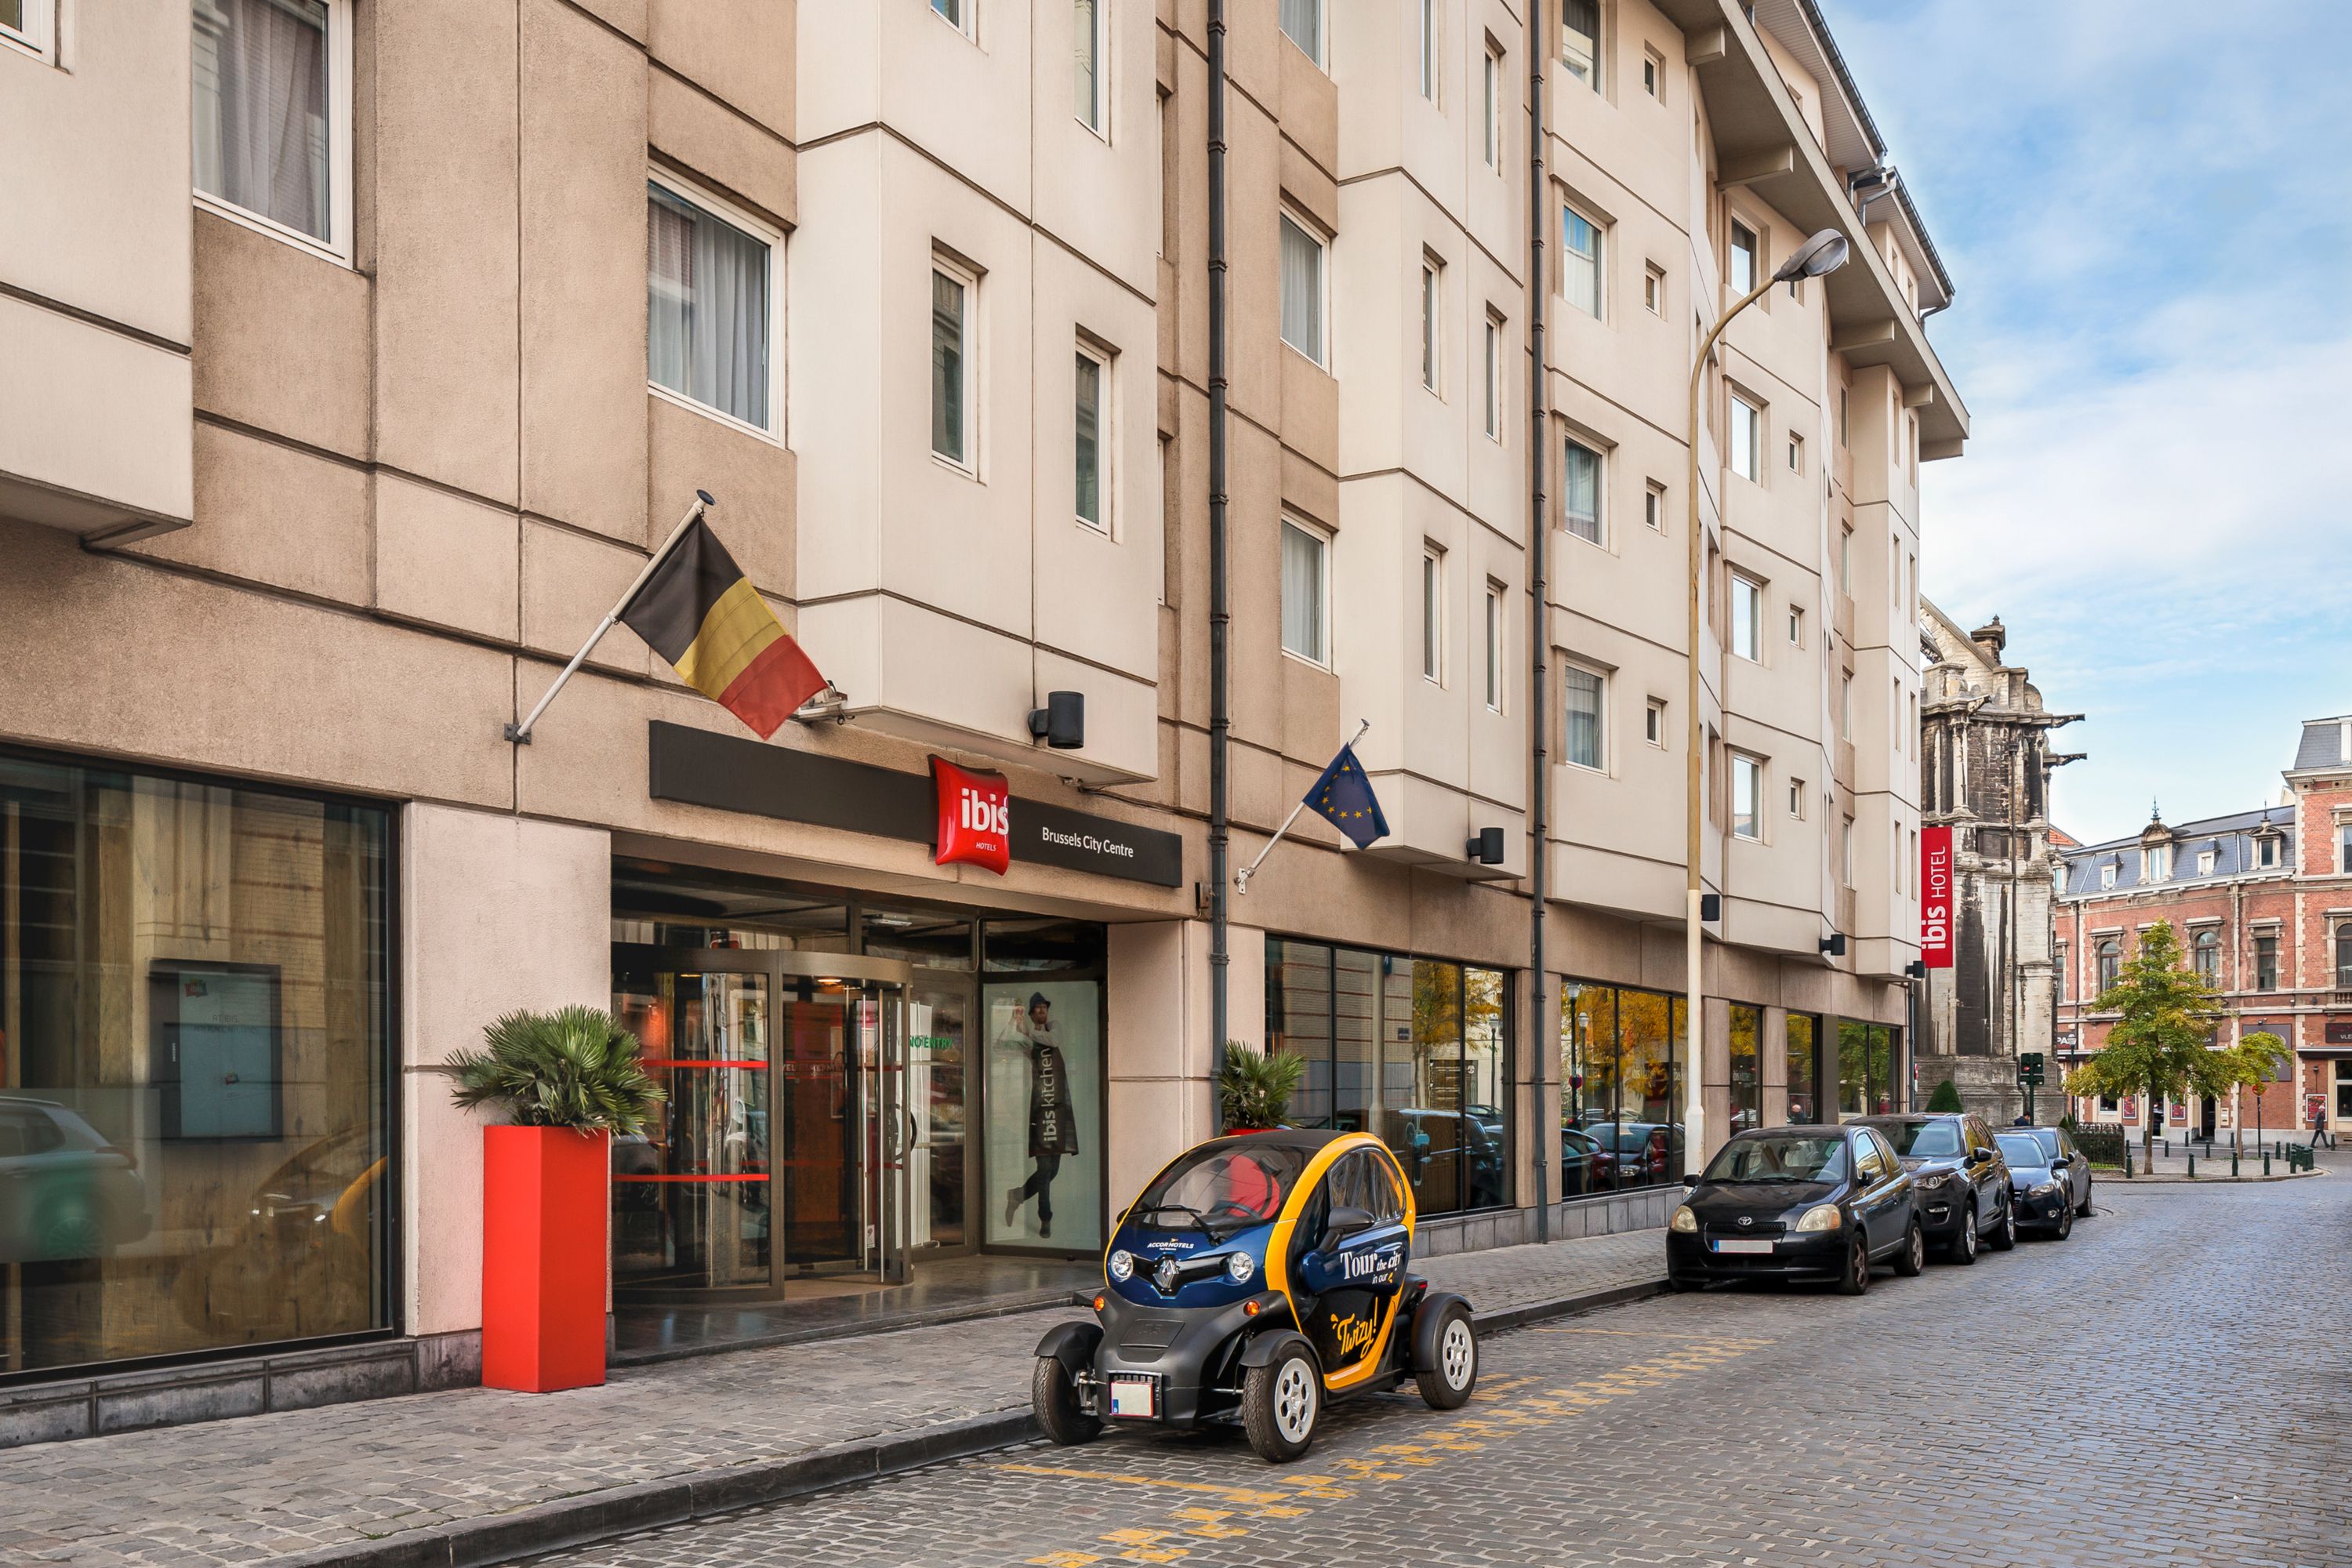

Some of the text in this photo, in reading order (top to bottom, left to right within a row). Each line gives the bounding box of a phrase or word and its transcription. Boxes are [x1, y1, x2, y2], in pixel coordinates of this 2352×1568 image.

[961, 787, 1009, 835] ibis
[975, 841, 996, 852] HOTELS
[1042, 826, 1134, 858] Brussels City Centre
[1921, 846, 1947, 950] ibis HOTEL
[924, 1036, 953, 1050] ENTRY
[1040, 1047, 1058, 1142] ibis kitchen
[1340, 1250, 1402, 1279] Tour the city
[1372, 1273, 1388, 1285] in our
[1338, 1297, 1378, 1359] Twizy!
